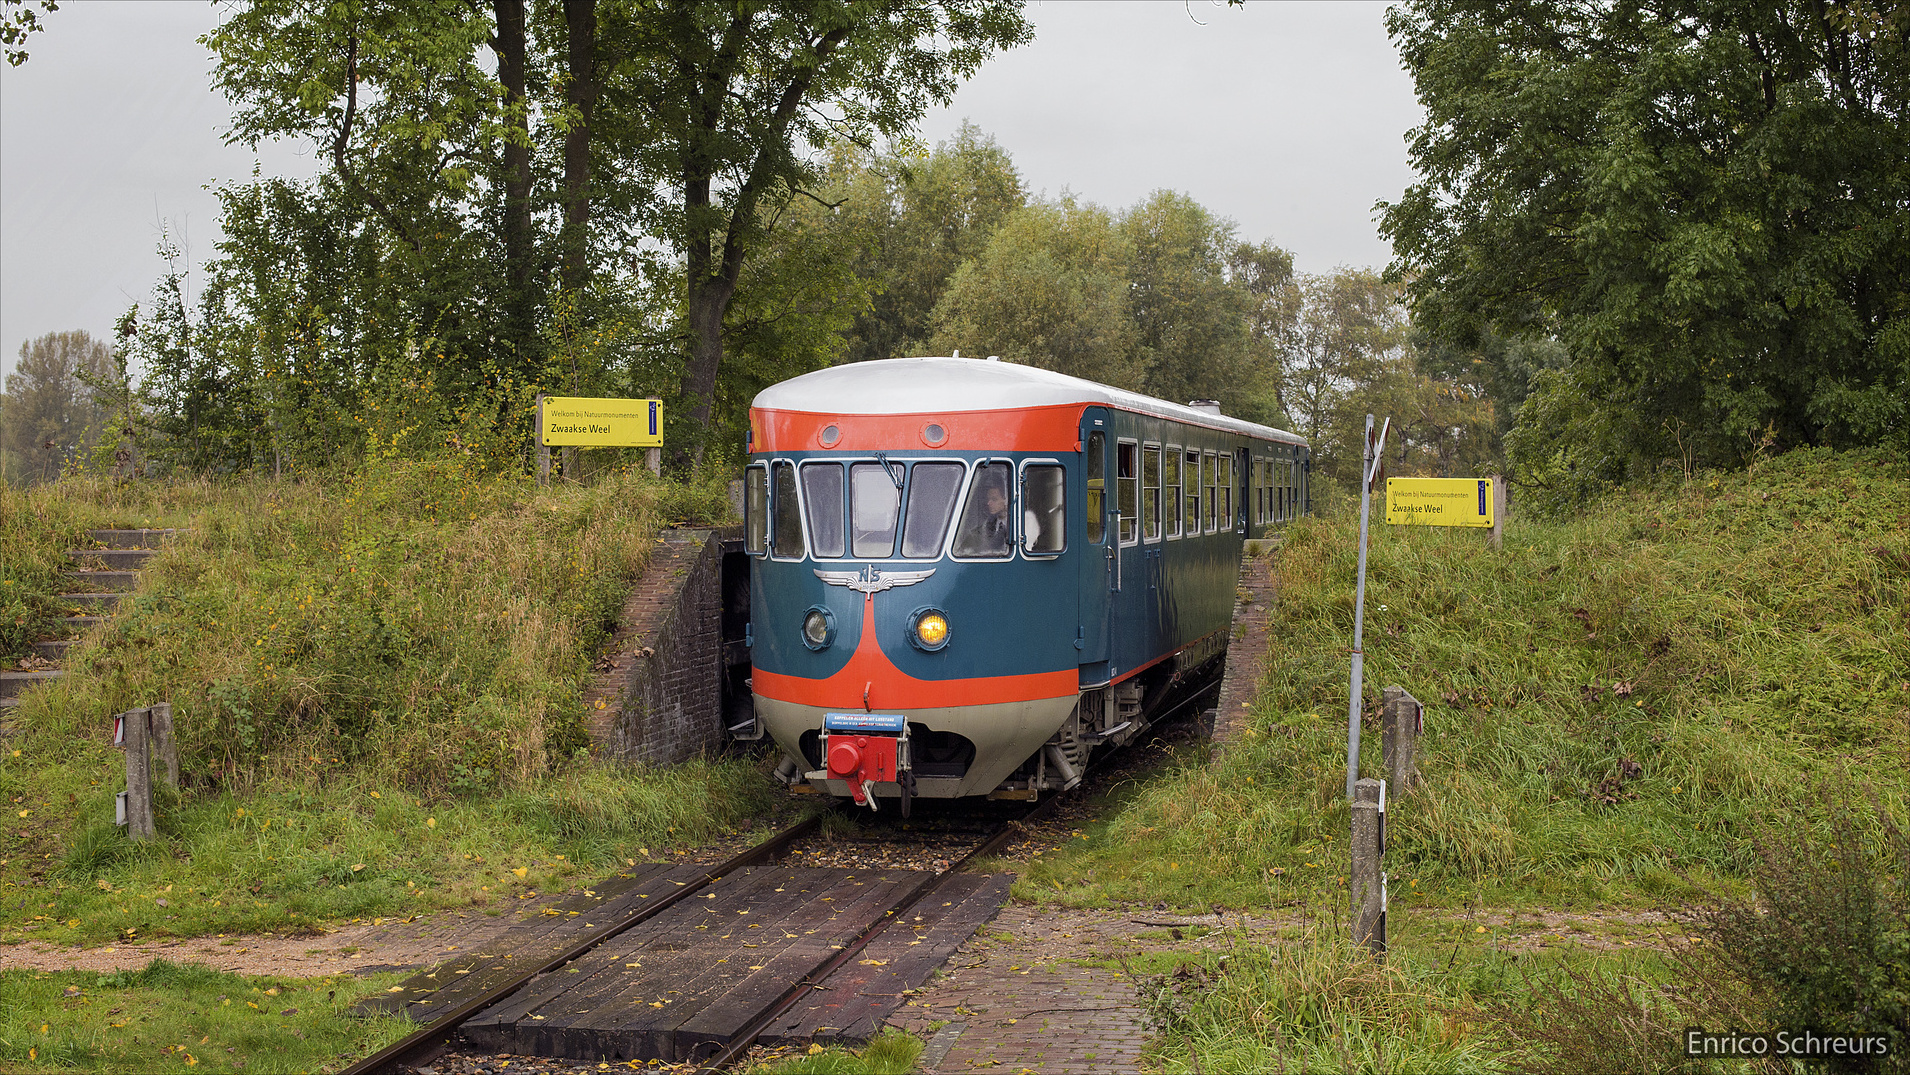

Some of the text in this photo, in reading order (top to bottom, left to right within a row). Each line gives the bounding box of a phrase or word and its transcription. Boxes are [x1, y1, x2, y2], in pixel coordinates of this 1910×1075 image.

[584, 411, 639, 419] Natuurmonumenten
[551, 423, 611, 433] Zwaakse Weel
[1420, 491, 1469, 499] Natuurmonumenten
[1392, 503, 1443, 513] Zwaakse Weel
